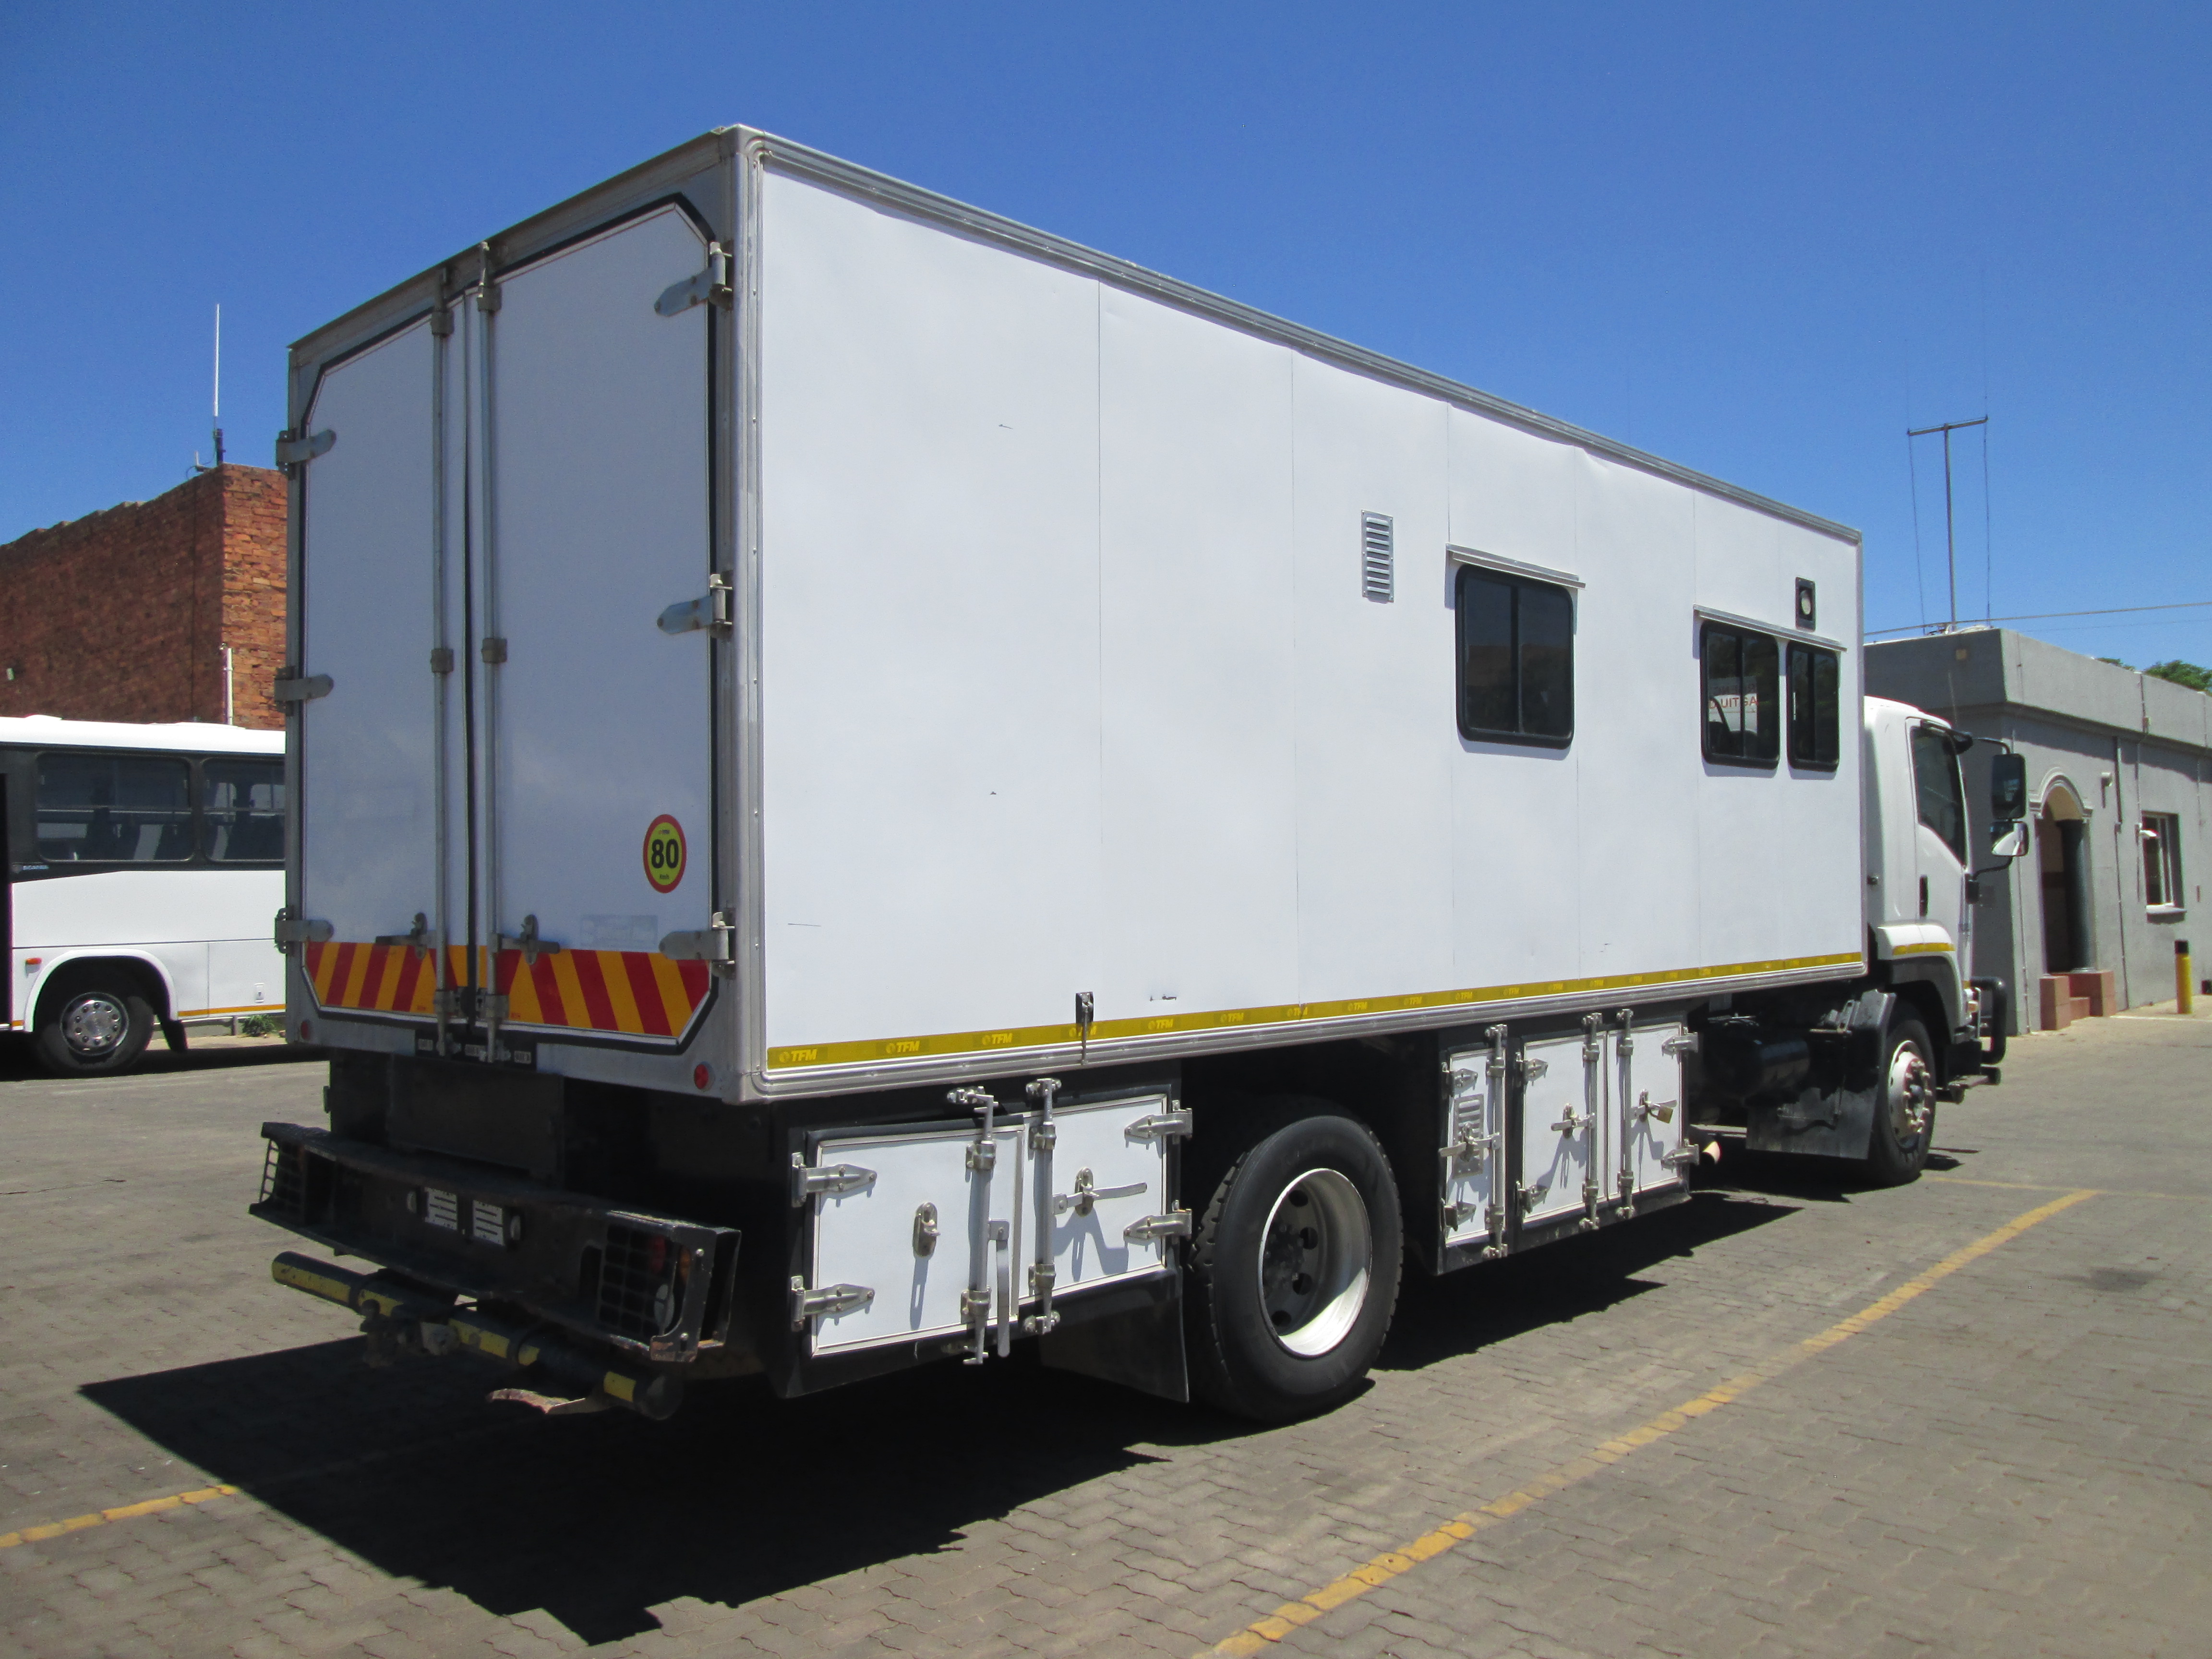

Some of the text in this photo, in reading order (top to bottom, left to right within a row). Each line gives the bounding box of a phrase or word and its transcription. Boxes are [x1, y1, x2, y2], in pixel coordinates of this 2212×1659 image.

[652, 839, 679, 868] 80
[1354, 1001, 1368, 1011] TFM
[1409, 997, 1422, 1005] TFM
[1227, 1012, 1244, 1022] TFM
[1156, 1018, 1174, 1029] TFM
[992, 1033, 1013, 1045] TFM
[896, 1040, 920, 1053] TFM
[791, 1048, 817, 1062] TFM
